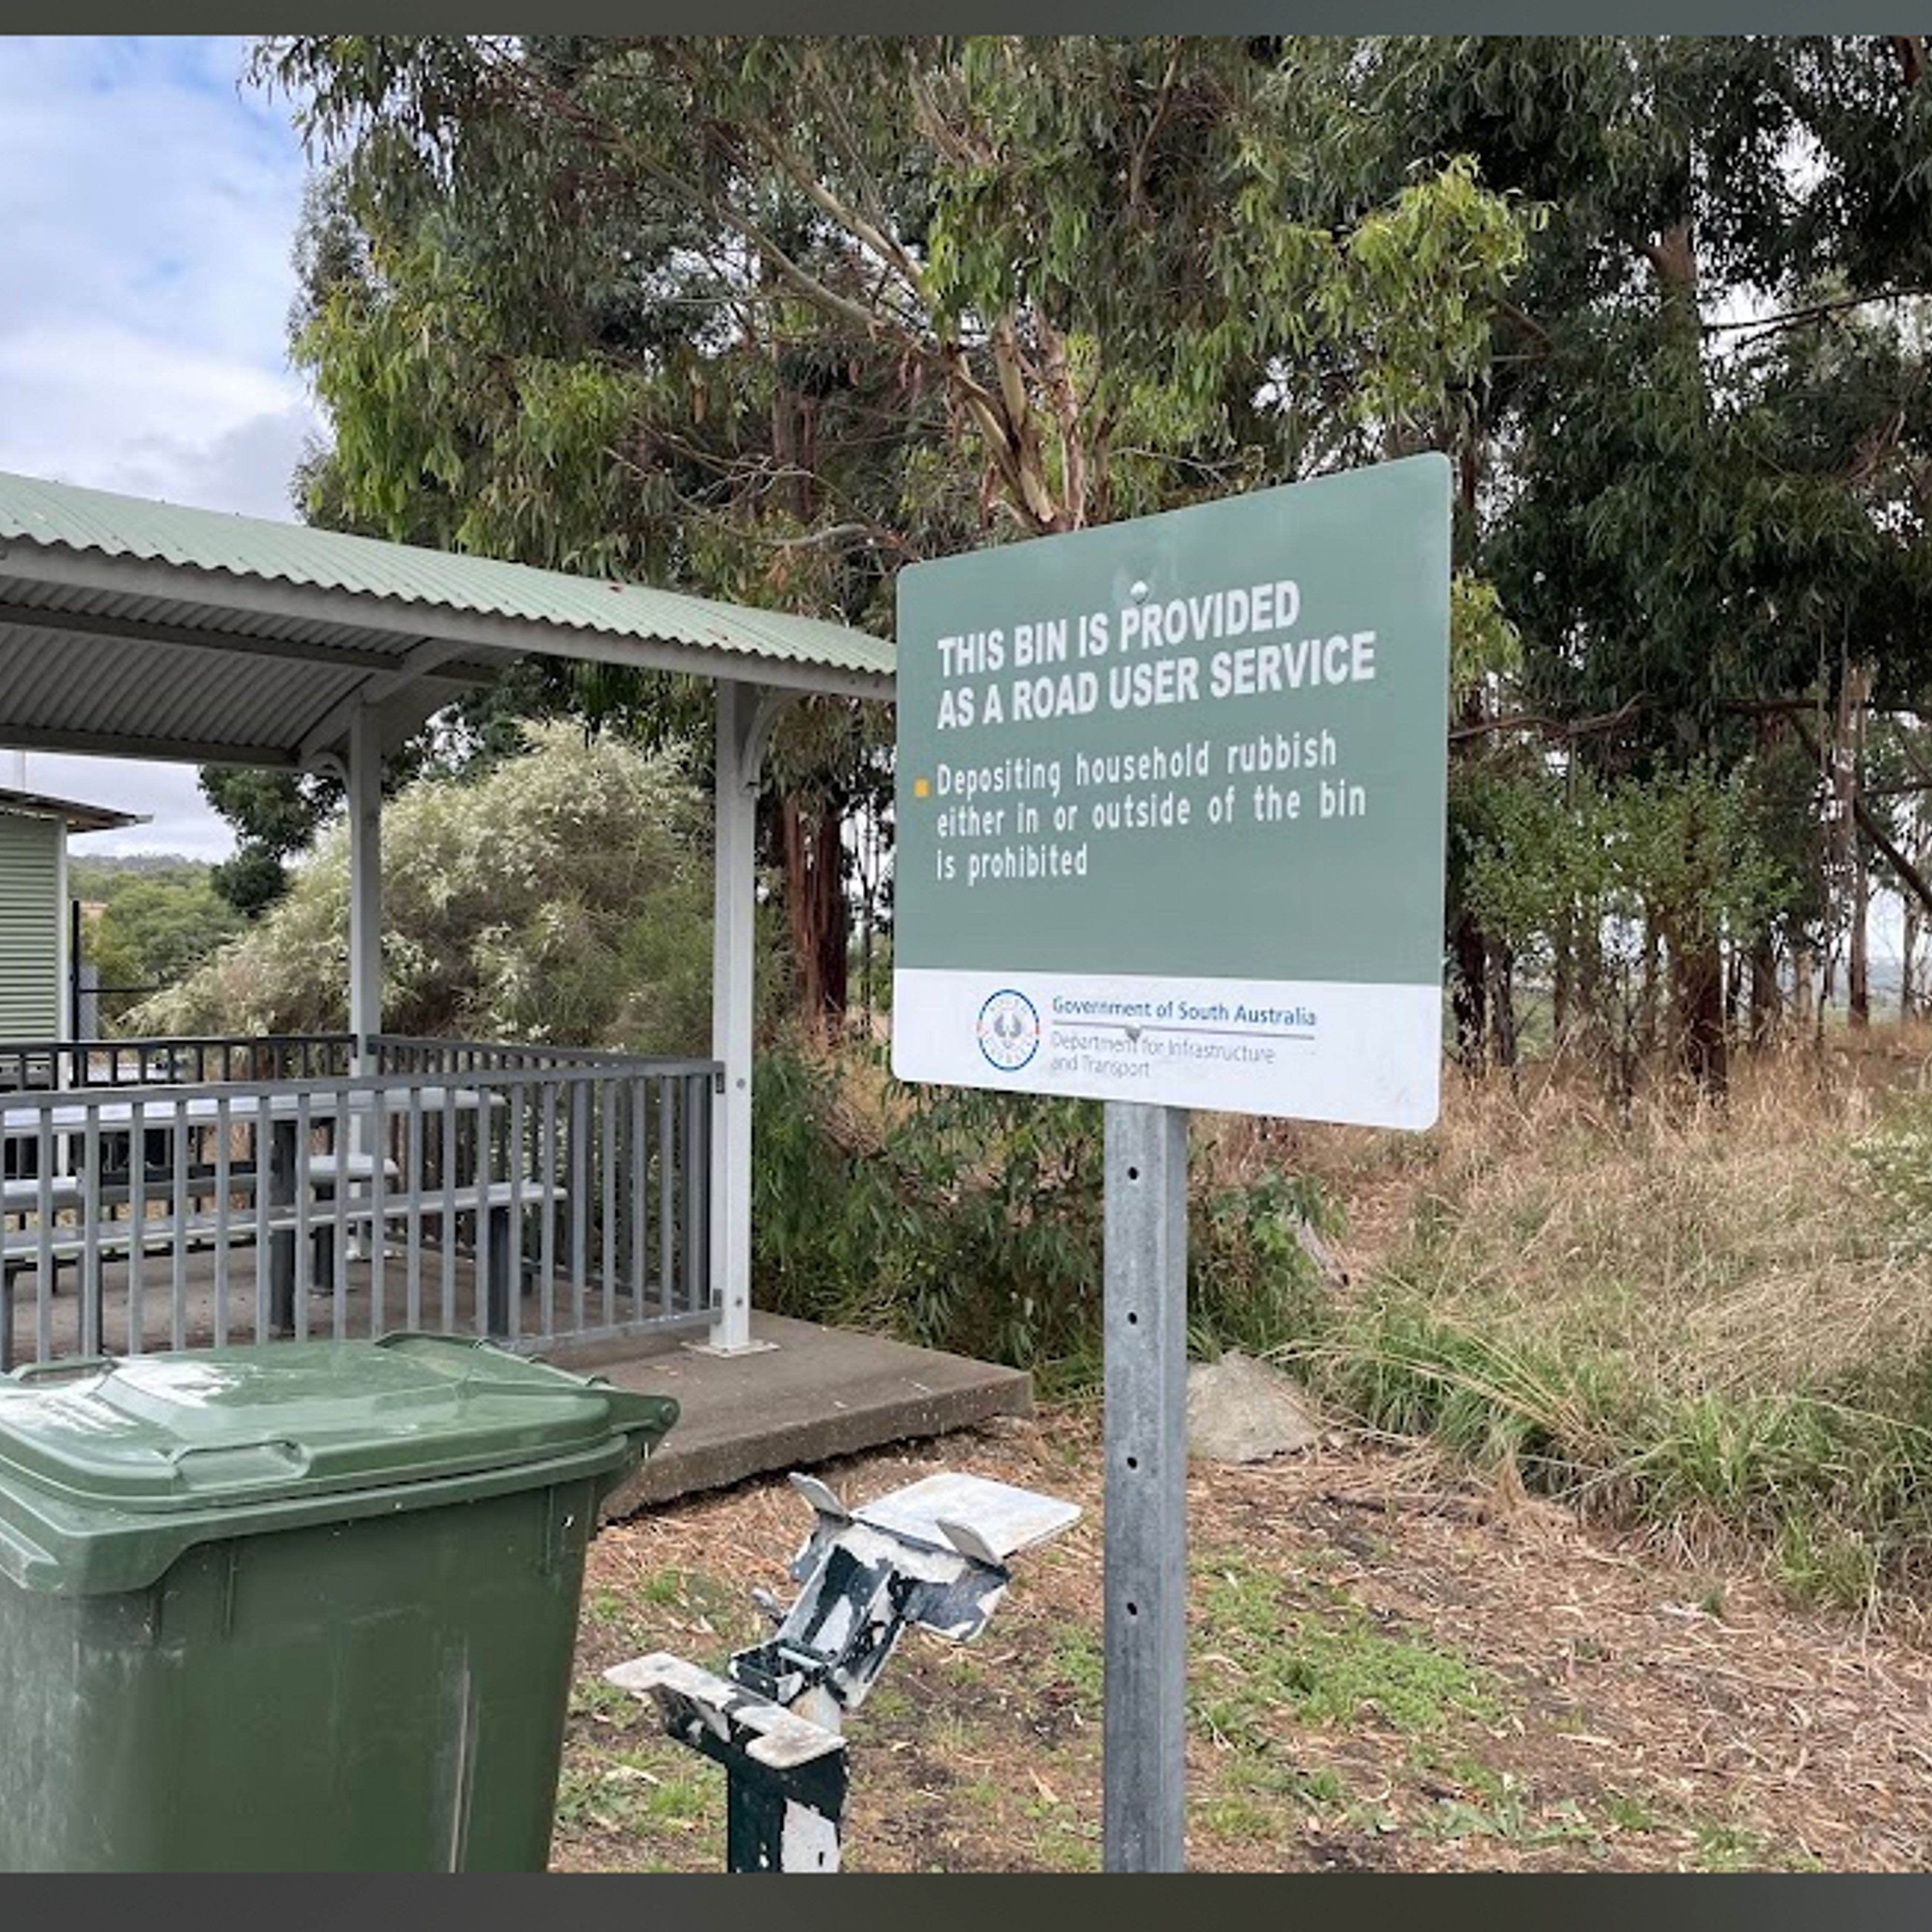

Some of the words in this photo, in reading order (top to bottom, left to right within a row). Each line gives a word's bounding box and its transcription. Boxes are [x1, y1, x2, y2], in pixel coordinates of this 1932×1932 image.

[937, 628, 1005, 678] THIS
[1014, 619, 1067, 667] BIN
[1079, 612, 1109, 658] IS
[1120, 580, 1300, 653] PROVIDED
[937, 687, 975, 730] AS
[982, 684, 1004, 724] A
[1012, 671, 1099, 721] ROAD
[1109, 657, 1199, 710] USER
[1210, 630, 1376, 698] SERVICE
[937, 757, 1060, 802] Depositing
[1077, 740, 1209, 786] household
[1228, 728, 1336, 774] rubbish
[937, 802, 1005, 838] either
[1018, 802, 1038, 833] in
[1053, 805, 1078, 831] or
[1092, 791, 1191, 830] outside
[1208, 785, 1235, 824] of
[1253, 783, 1300, 821] the
[1320, 779, 1365, 818] bin
[937, 849, 956, 880] is
[968, 843, 1087, 886] prohibited
[1052, 996, 1151, 1016] Government
[1157, 1001, 1173, 1018] of
[1179, 1001, 1229, 1020] South
[1234, 1004, 1316, 1026] Australia
[1051, 1054, 1078, 1070] and
[1082, 1055, 1150, 1079] Transport
[1141, 1037, 1164, 1055] for
[1168, 1038, 1276, 1064] Infrastructure
